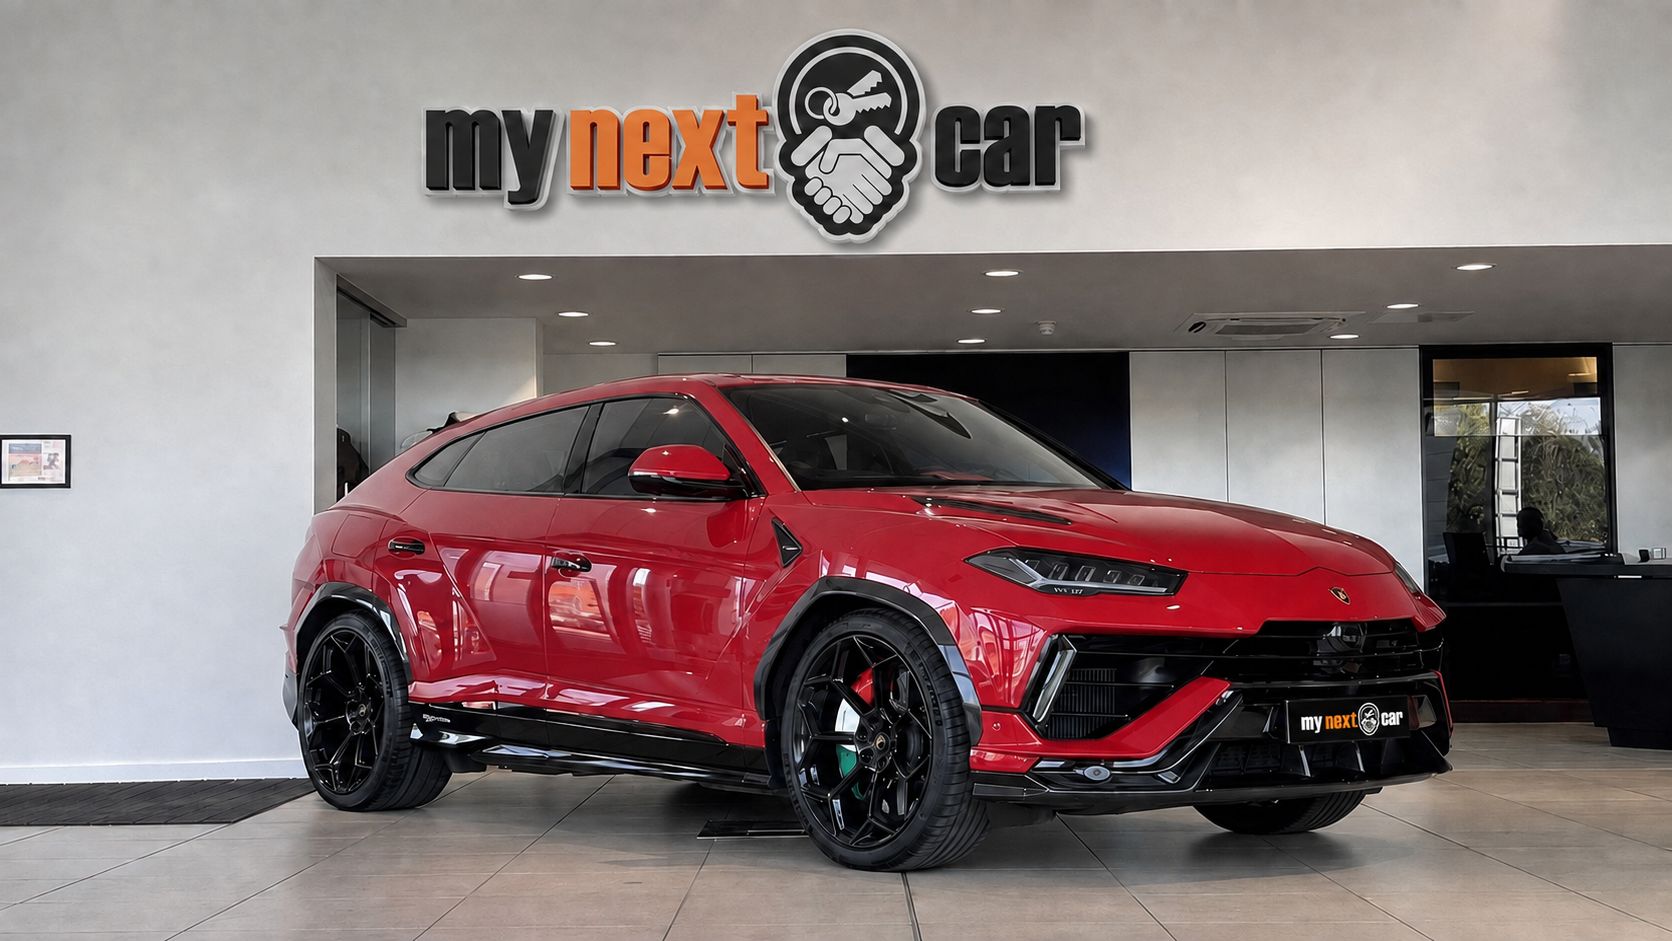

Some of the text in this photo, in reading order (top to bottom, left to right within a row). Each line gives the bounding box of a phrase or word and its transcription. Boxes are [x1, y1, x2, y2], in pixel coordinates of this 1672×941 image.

[425, 94, 1082, 205] my next car
[1301, 711, 1404, 734] my next car
